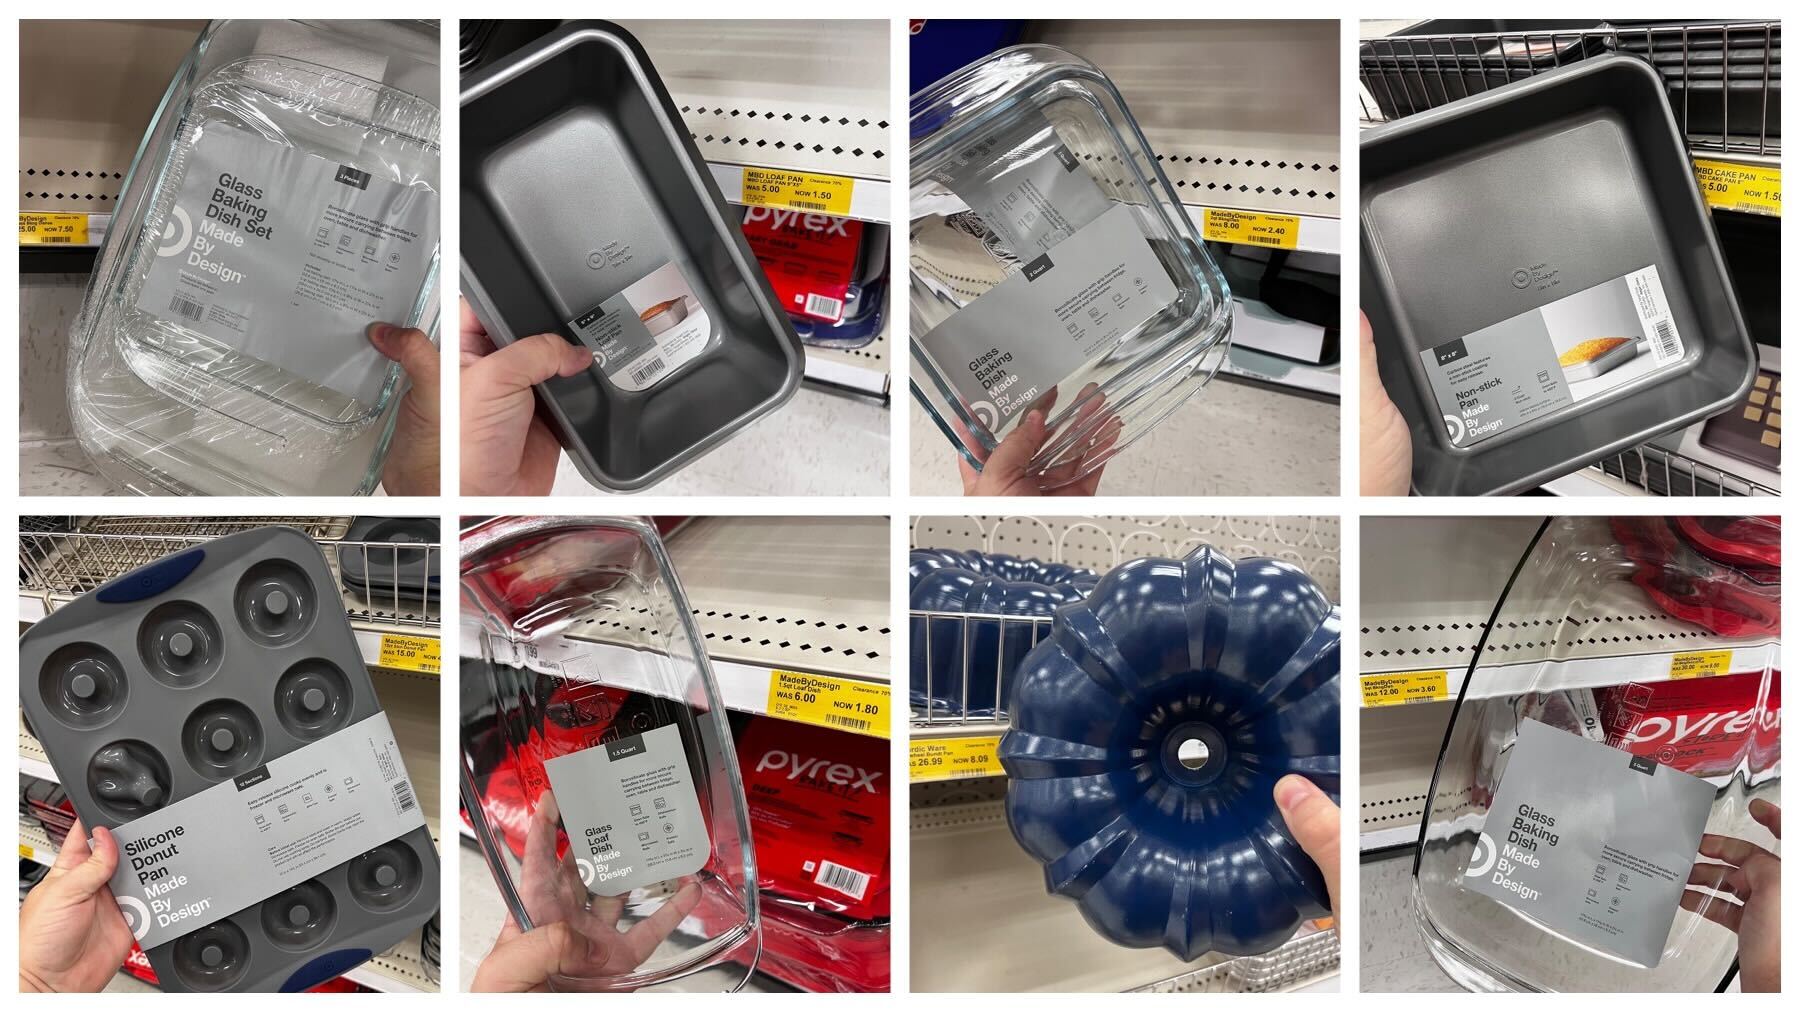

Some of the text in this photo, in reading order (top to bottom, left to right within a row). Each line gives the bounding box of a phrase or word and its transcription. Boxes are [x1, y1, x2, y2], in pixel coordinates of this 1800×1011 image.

[1715, 170, 1738, 178] CAKE
[1739, 172, 1756, 181] PAN
[219, 173, 263, 200] Glass
[762, 184, 780, 192] 5.00
[813, 191, 831, 200] 1.50
[1708, 182, 1728, 192] 5.00
[1744, 190, 1762, 198] NOW
[212, 188, 268, 222] Baking
[206, 204, 272, 240] Dish Set
[1224, 222, 1239, 230] 8.00
[199, 220, 244, 247] Made
[193, 236, 215, 256] By
[602, 340, 618, 350] Made
[969, 348, 999, 371] Glass
[975, 352, 1012, 381] Baking
[982, 369, 1006, 390] Dish
[988, 374, 1018, 400] Made
[1456, 377, 1502, 400] Non-stick
[996, 394, 1010, 408] By
[1459, 398, 1478, 410] Pan
[1462, 404, 1490, 419] Made
[1466, 418, 1478, 428] By
[398, 650, 415, 658] 15.00
[780, 674, 878, 694] MadeByDesign Clearance
[1380, 688, 1398, 696] 12.00
[776, 691, 878, 715] WAS 6.00 NOW 1.80
[620, 746, 636, 754] Quart
[918, 758, 942, 766] 26.99
[970, 755, 988, 764] 8.09
[756, 750, 882, 794] pyrex
[1518, 804, 1555, 826] Glass
[124, 825, 185, 856] Silicone
[585, 824, 612, 837] Glass
[588, 833, 610, 846] Loaf
[1512, 816, 1559, 846] Baking
[590, 843, 613, 855] Dish
[1508, 830, 1538, 852] Dish
[130, 844, 179, 871] Donut
[594, 851, 621, 864] Made
[1502, 844, 1540, 868] Made
[138, 866, 168, 886] Pan
[596, 863, 609, 874] By
[1498, 858, 1516, 876] By
[144, 875, 188, 900] Made
[150, 898, 172, 914] By
